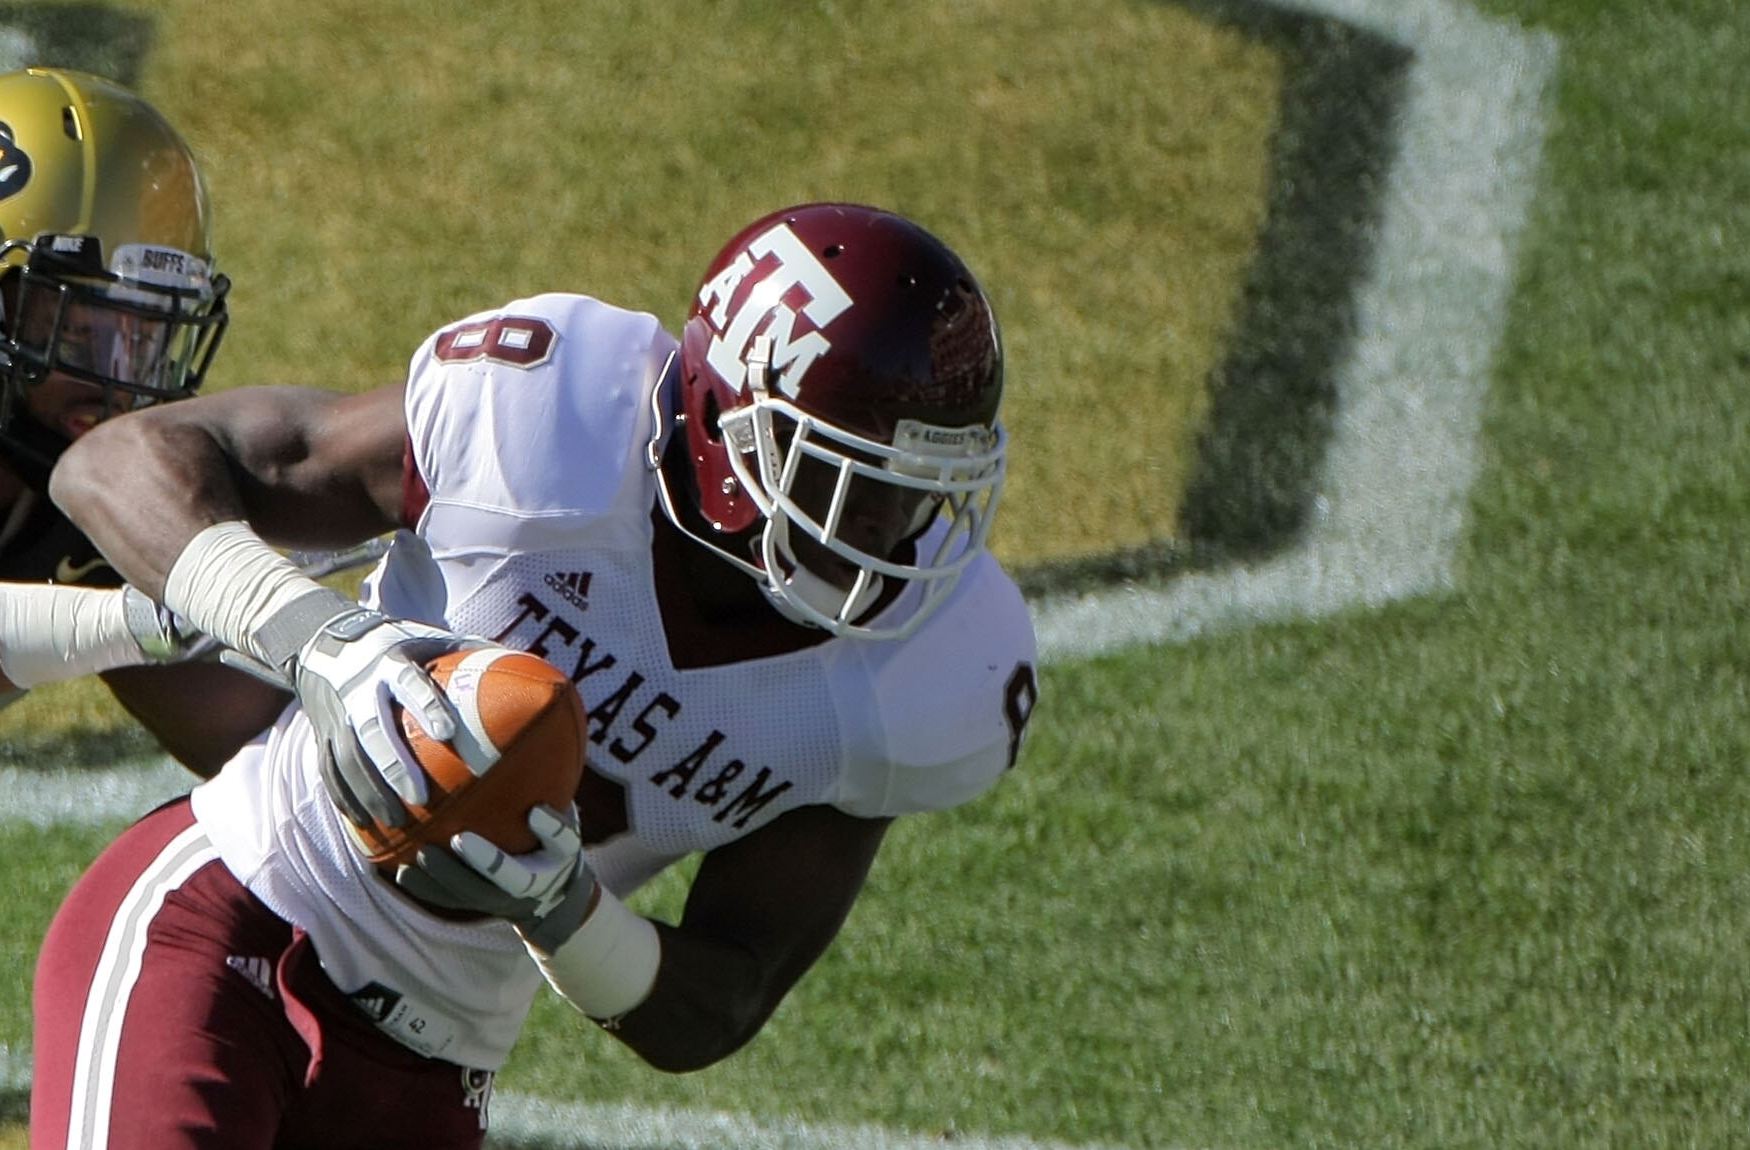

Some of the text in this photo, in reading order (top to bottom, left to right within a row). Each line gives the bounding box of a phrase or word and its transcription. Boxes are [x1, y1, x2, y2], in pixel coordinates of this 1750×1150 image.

[143, 249, 185, 275] BUFFS
[433, 316, 559, 371] 8
[650, 729, 793, 829] A&M
[409, 1017, 427, 1035] 42
